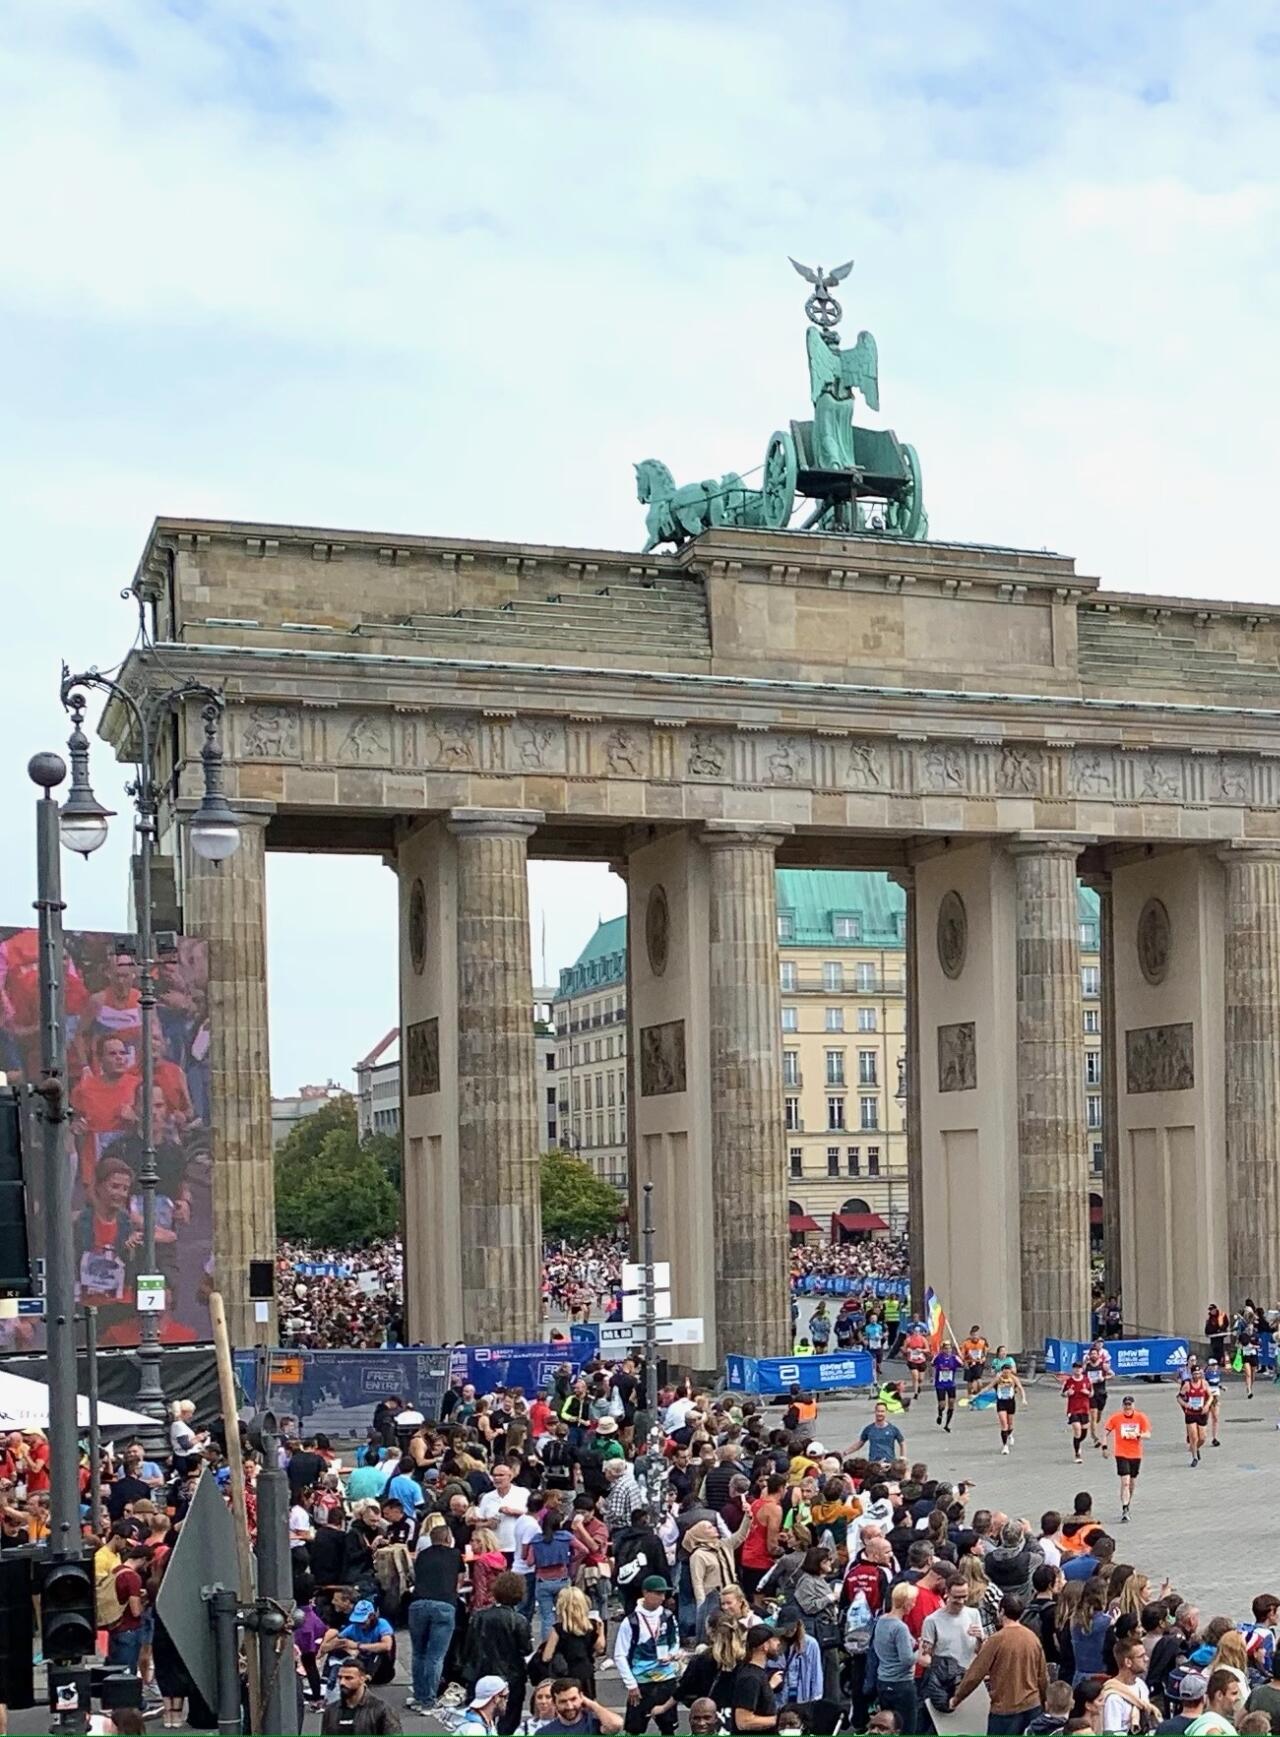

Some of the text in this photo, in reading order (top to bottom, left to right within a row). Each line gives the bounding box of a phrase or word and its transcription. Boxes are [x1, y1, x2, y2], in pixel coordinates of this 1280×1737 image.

[147, 1296, 156, 1305] 7
[1118, 1350, 1138, 1358] BMW
[820, 1363, 842, 1372] BMW
[367, 1371, 396, 1381] FREE
[365, 1381, 401, 1391] ENTRY
